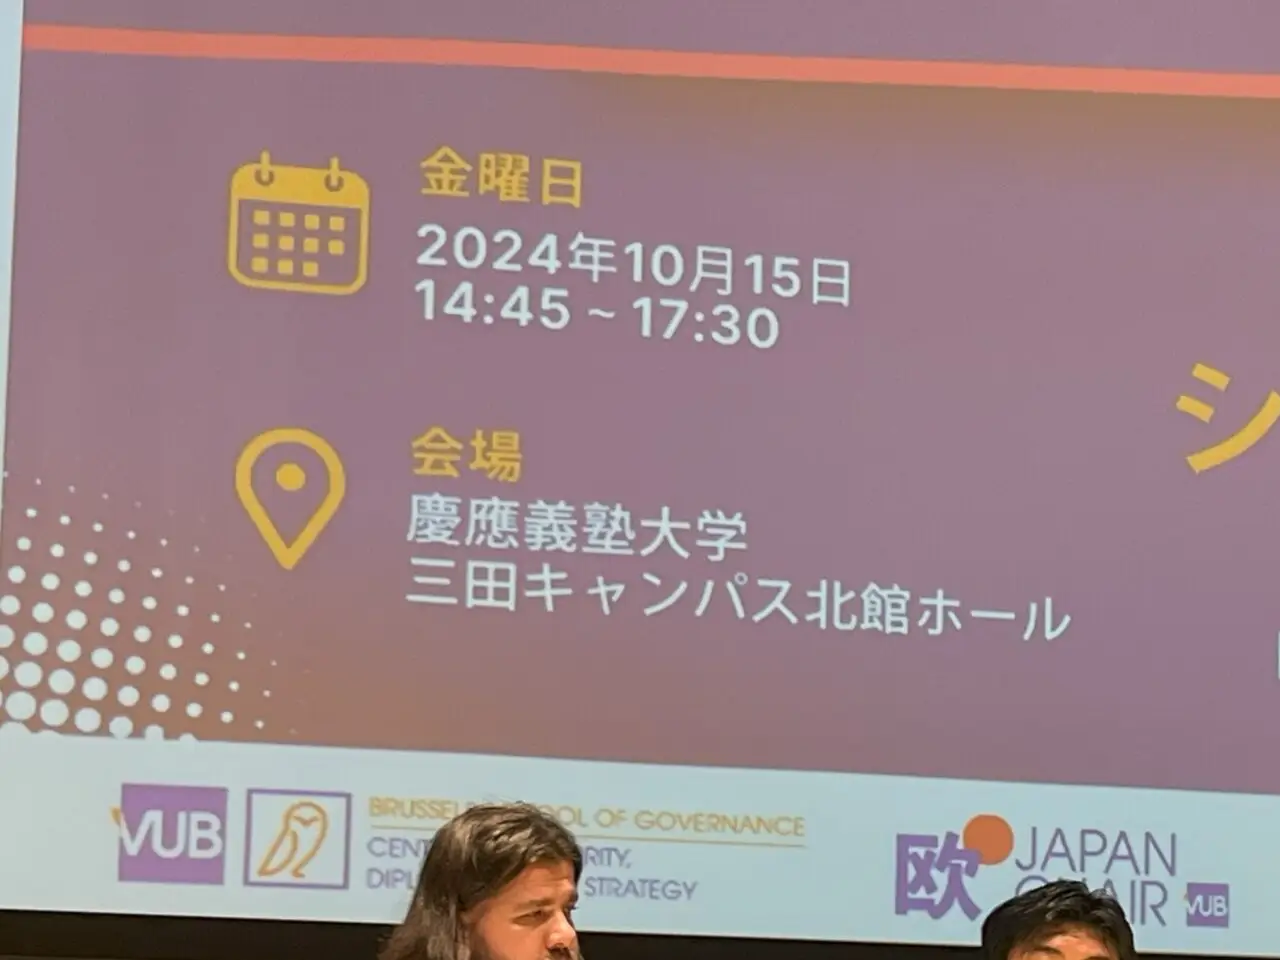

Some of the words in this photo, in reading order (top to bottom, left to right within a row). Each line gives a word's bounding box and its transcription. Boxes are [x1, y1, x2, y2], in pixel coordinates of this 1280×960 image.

[419, 145, 585, 208] 金曜日
[415, 223, 852, 308] 2024年10月15日
[414, 278, 571, 331] 14:45
[633, 296, 780, 350] 17:30
[411, 426, 523, 483] 会場
[406, 492, 749, 563] 慶應義塾大学
[404, 557, 1073, 643] 三田キャンパス北館ホール
[115, 808, 226, 860] VUB
[369, 796, 472, 820] BRUSSEL
[593, 808, 627, 829] OF
[633, 809, 807, 837] GOVERNANCE
[895, 831, 982, 921] 欧
[1015, 827, 1176, 877] JAPAN
[584, 876, 699, 901] STRATEGY
[1186, 894, 1228, 918] VUB
